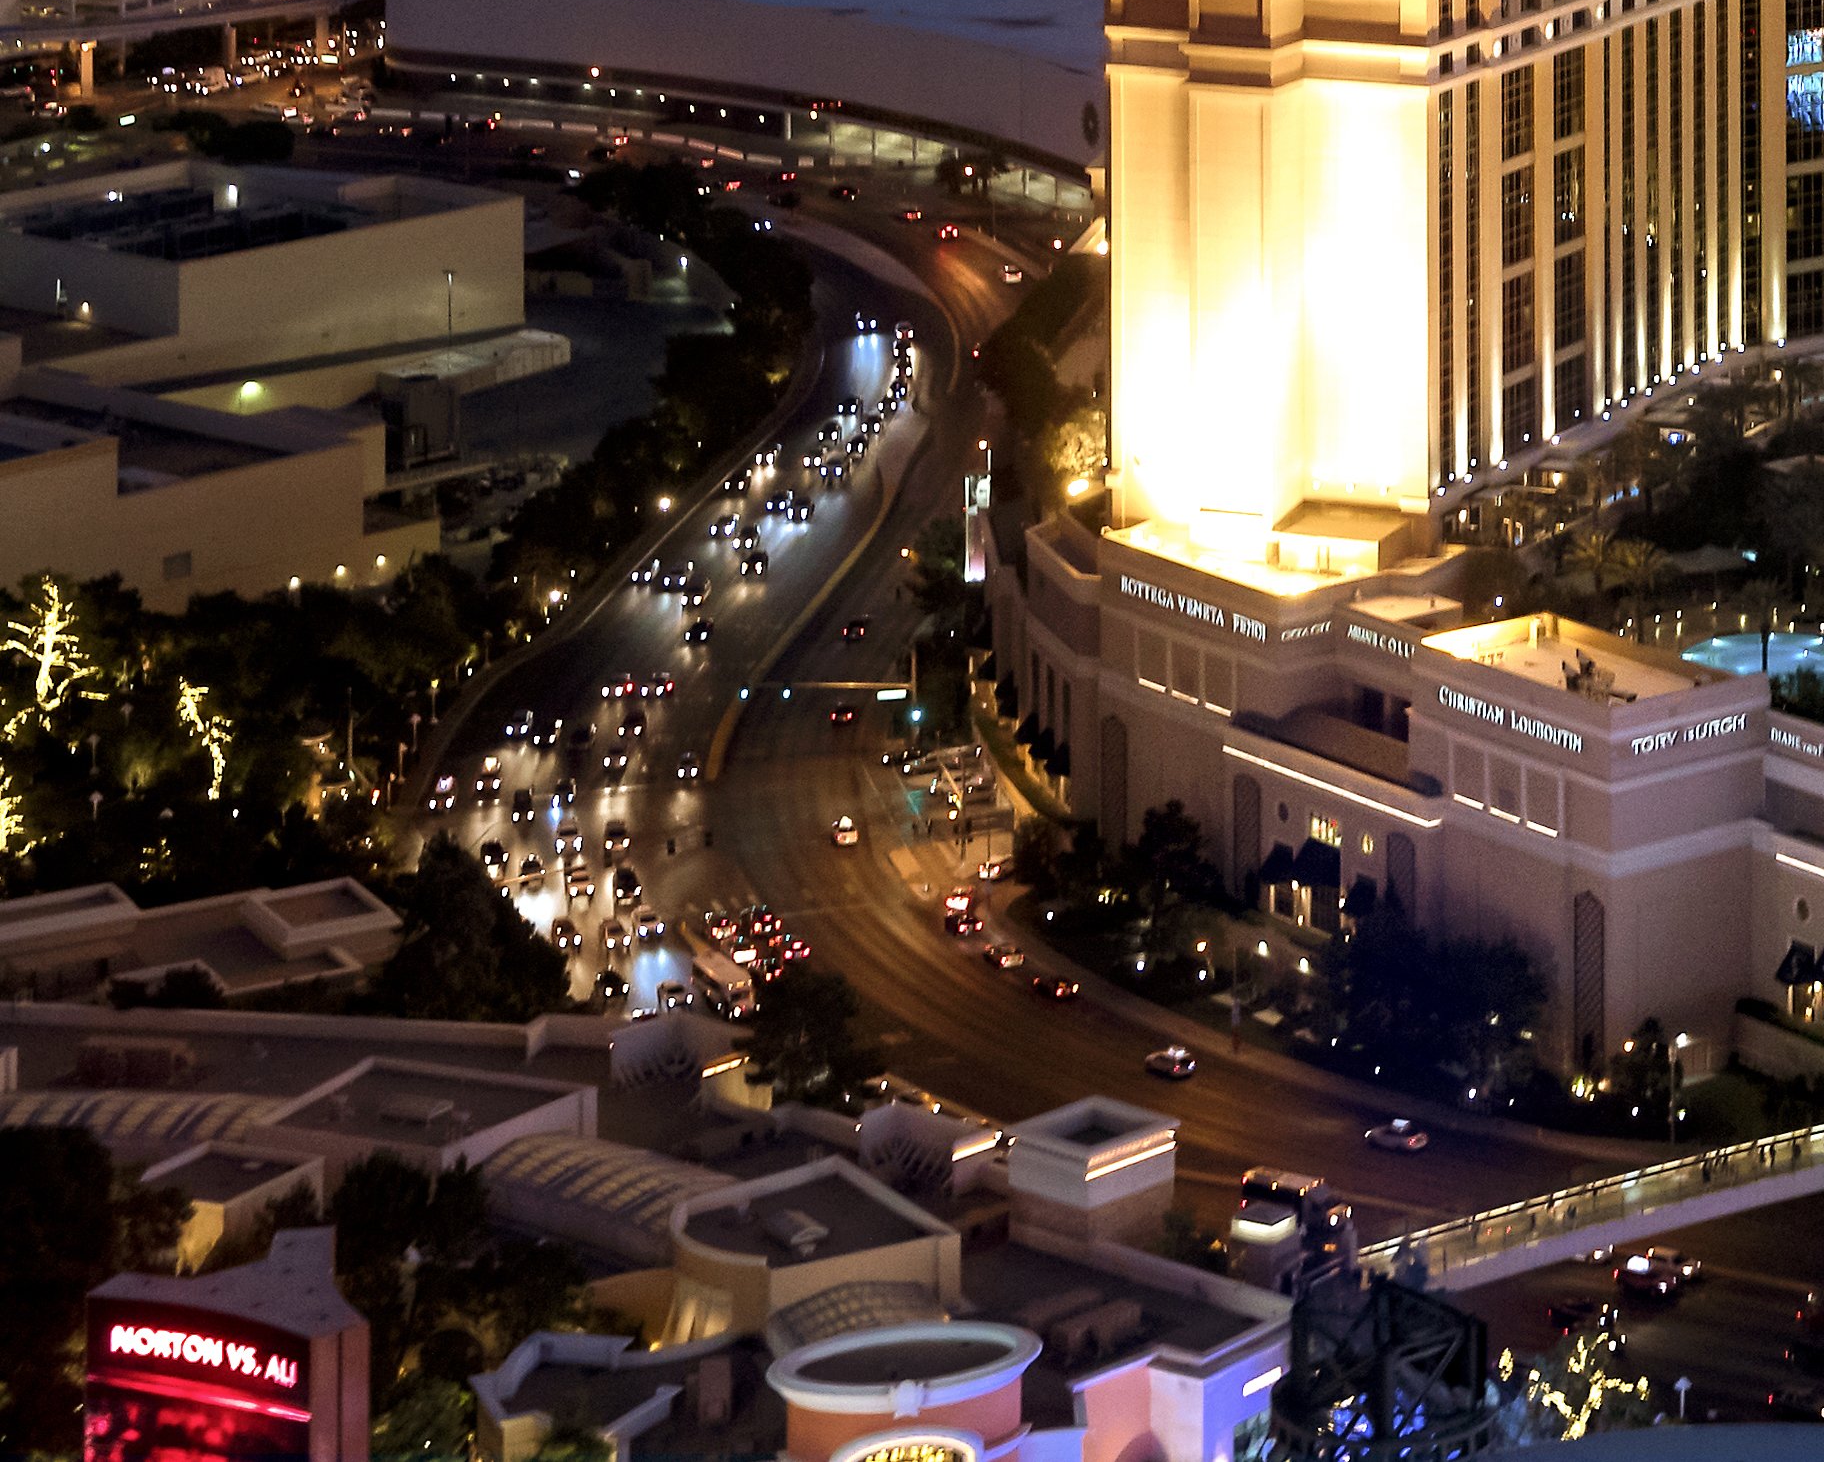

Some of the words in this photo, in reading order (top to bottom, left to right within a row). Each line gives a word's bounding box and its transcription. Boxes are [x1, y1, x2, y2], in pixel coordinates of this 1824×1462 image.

[1121, 574, 1174, 610] BOTTEGA
[1177, 593, 1225, 627] VENETA
[1438, 685, 1504, 725] CHRISTIAN
[1511, 709, 1584, 754] LOUBOUTIN
[1632, 729, 1678, 756] TORY
[1683, 712, 1747, 743] BURCH
[1770, 726, 1800, 750] DIANE
[110, 1325, 223, 1367] NORTON
[263, 1354, 298, 1388] ALI
